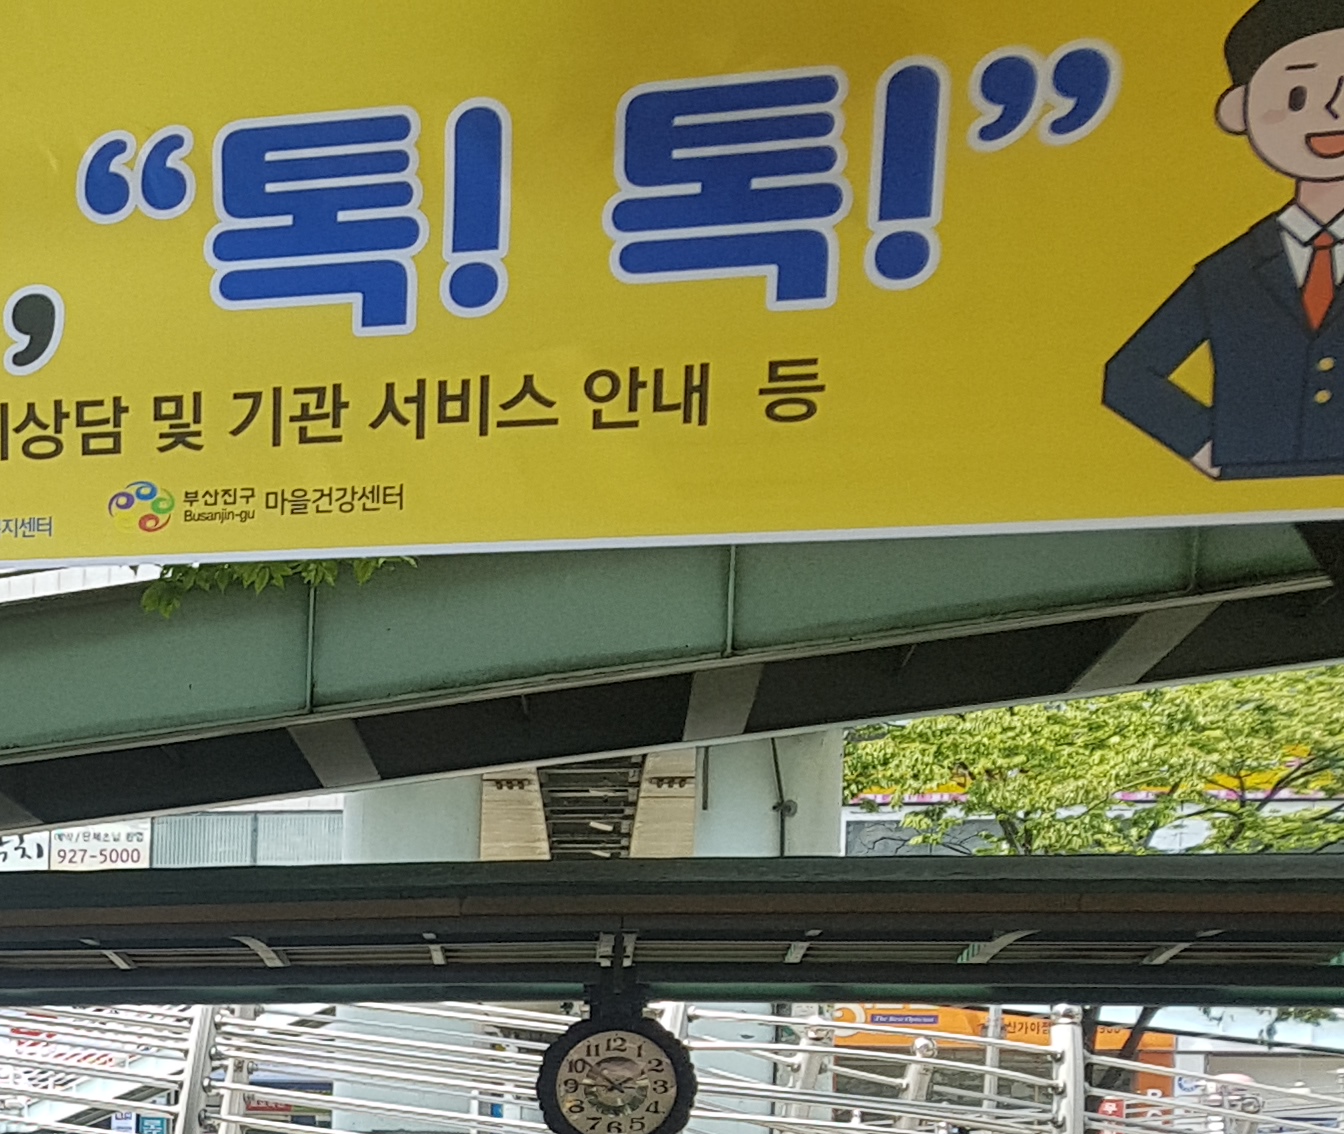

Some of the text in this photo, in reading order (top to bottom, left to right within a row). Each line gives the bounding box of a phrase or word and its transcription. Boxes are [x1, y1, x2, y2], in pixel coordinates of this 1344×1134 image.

[152, 393, 205, 455] 및
[228, 382, 349, 447] 기관
[368, 371, 558, 443] 서비스
[582, 361, 711, 431] 안내
[757, 357, 828, 425] 등
[183, 483, 405, 516] 부산진구 마을건강센터
[183, 507, 256, 524] Busanjin-gu
[57, 847, 141, 864] 927-5000
[586, 1044, 600, 1057] 11
[605, 1037, 627, 1052] 12
[636, 1045, 643, 1058] 1
[567, 1058, 586, 1073] 10
[648, 1059, 664, 1073] 2
[564, 1078, 579, 1093] 9
[653, 1080, 668, 1094] 3
[568, 1100, 584, 1114] 8
[645, 1101, 660, 1114] 4
[586, 1117, 602, 1131] 7
[607, 1121, 622, 1134] 6
[629, 1117, 645, 1131] 5
